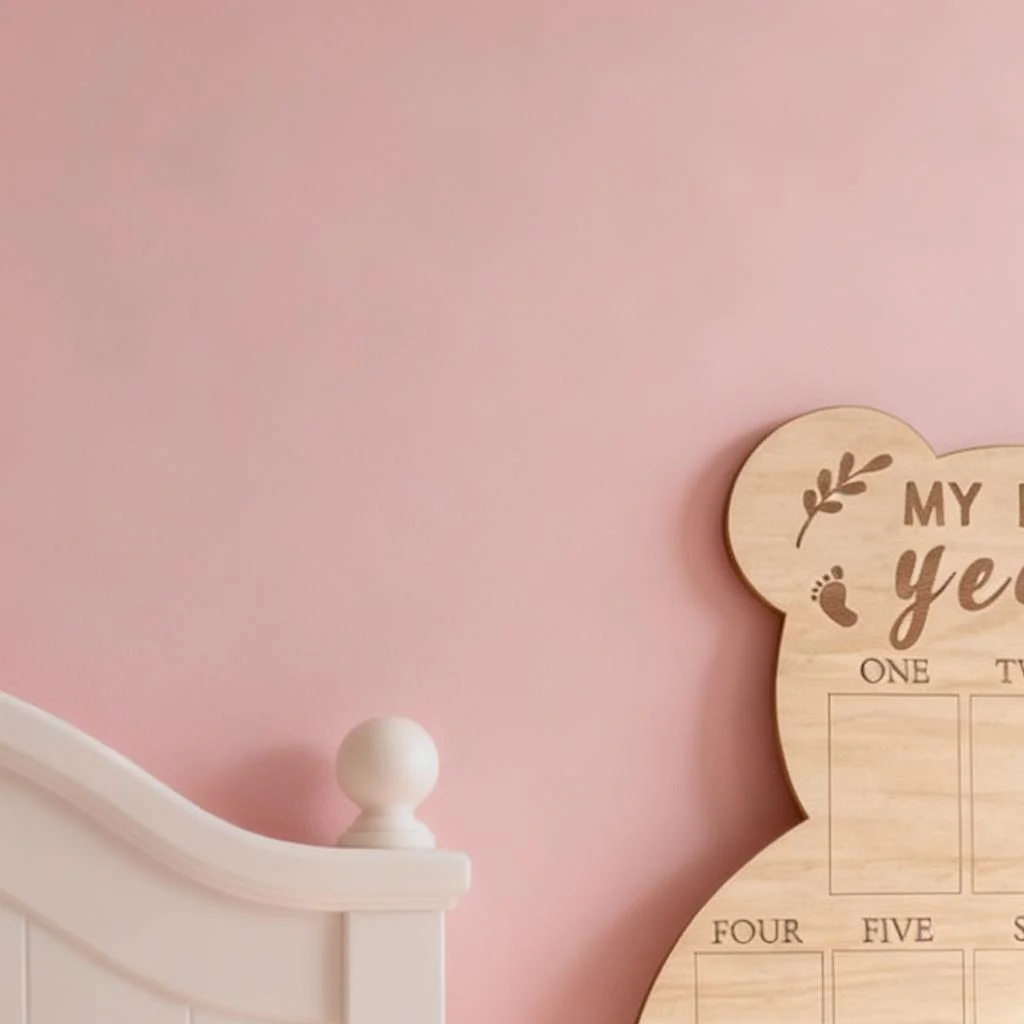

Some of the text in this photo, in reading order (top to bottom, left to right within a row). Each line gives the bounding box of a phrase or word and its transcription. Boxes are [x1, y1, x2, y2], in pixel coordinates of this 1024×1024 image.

[903, 480, 983, 528] MY
[859, 657, 931, 685] ONE
[711, 918, 804, 945] FOUR
[862, 916, 934, 944] FIVE
